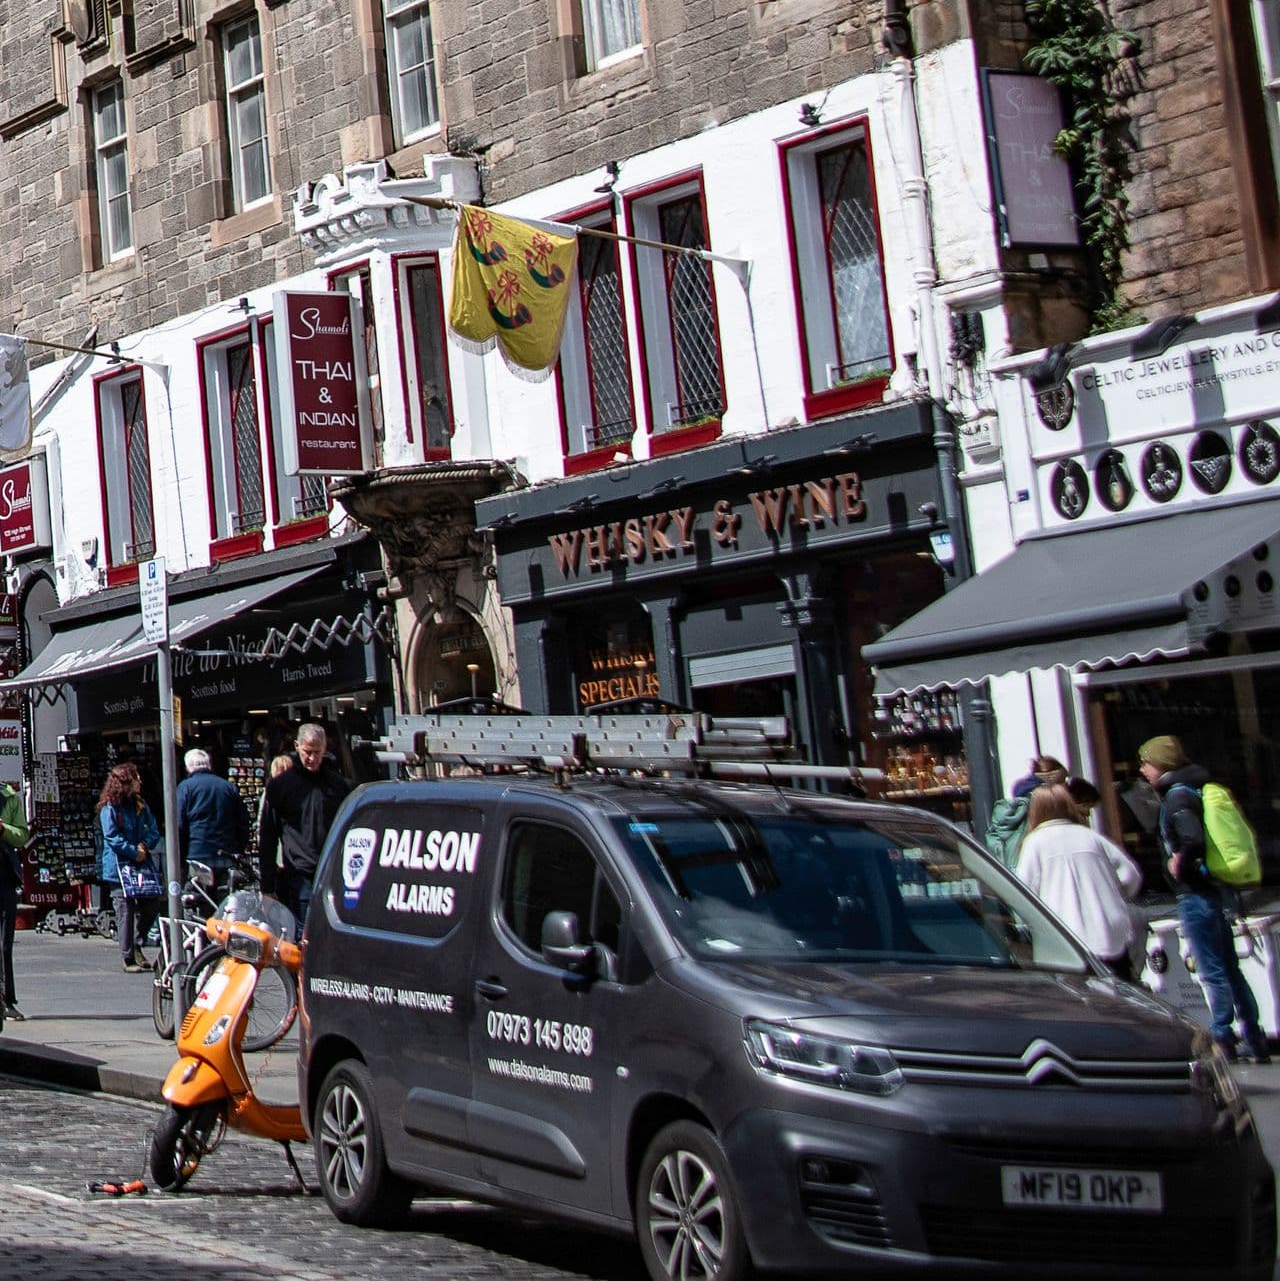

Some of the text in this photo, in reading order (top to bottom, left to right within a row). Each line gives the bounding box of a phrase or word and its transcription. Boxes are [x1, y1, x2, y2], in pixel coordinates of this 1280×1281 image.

[291, 307, 349, 340] Shamoli
[296, 360, 352, 381] THAI
[1081, 367, 1134, 391] CELTIC
[1138, 346, 1227, 379] JEWELLERY
[1232, 337, 1267, 358] AND
[318, 387, 333, 404] &
[299, 411, 356, 427] INDIAN
[301, 439, 357, 449] restaurant
[547, 472, 866, 579] WHISKY & WINE
[149, 563, 155, 578] P
[282, 660, 332, 683] Harris Tweed
[191, 678, 237, 699] Scottish food
[580, 673, 660, 705] SPECIALIS
[103, 695, 128, 716] Scottish
[379, 828, 481, 873] DALSON
[386, 883, 456, 916] ALARMS
[309, 977, 343, 998] WIRELESS
[343, 984, 369, 1002] ALARMS
[373, 987, 393, 1003] CCTV
[397, 989, 454, 1014] MAINTENANCE
[487, 1010, 593, 1056] 07973 145 898
[487, 1057, 593, 1093] www.dalsonalarms.com
[1018, 1171, 1082, 1200] MF19
